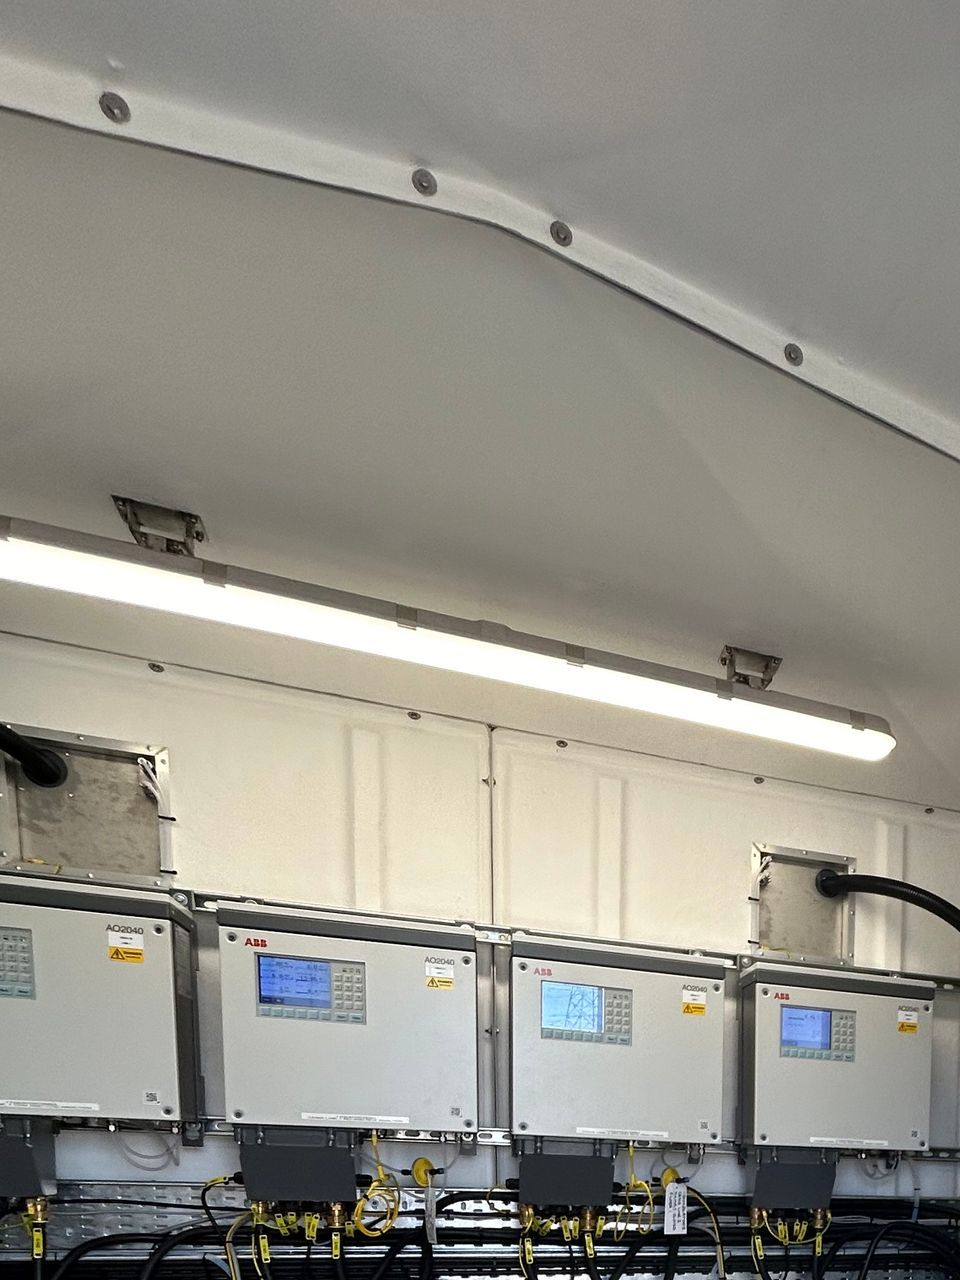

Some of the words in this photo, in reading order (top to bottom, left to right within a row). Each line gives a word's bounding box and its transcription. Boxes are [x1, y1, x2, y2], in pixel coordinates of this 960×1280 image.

[106, 924, 144, 935] AO2040
[244, 938, 268, 948] ABB
[424, 956, 455, 966] AO2040
[534, 967, 553, 977] ABB
[682, 984, 708, 993] AO2040
[774, 992, 790, 1001] ABB
